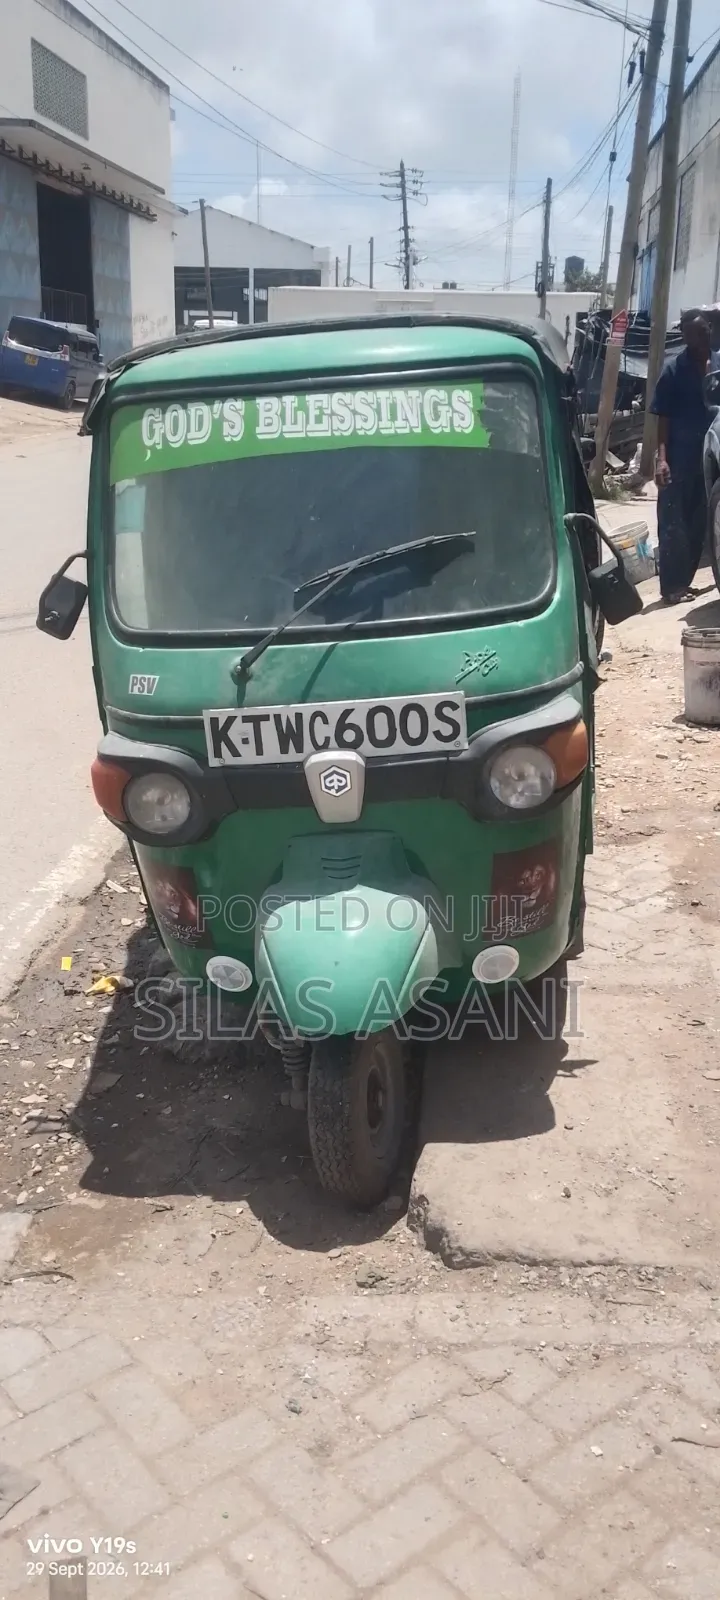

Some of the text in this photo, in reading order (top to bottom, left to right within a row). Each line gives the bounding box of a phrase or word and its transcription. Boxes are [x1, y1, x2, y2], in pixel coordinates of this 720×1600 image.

[142, 388, 474, 450] GOD'S BLESSINGS
[130, 675, 157, 694] PSV
